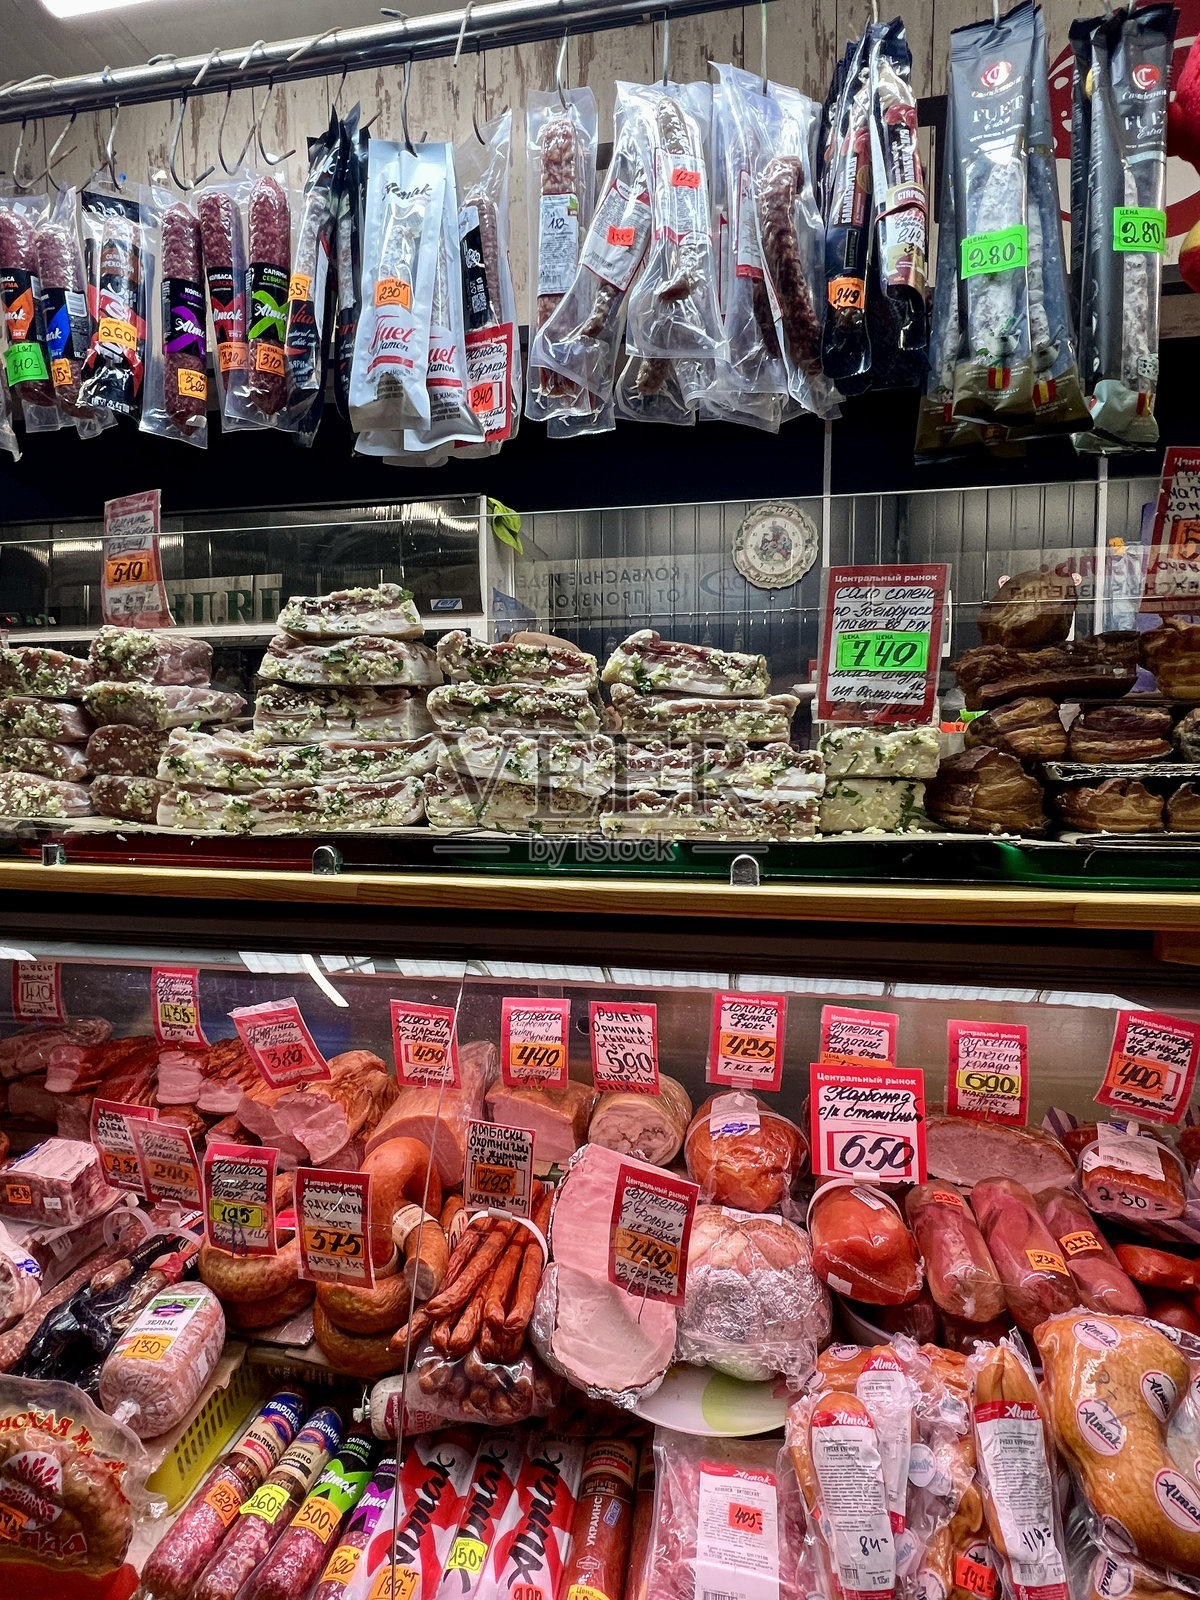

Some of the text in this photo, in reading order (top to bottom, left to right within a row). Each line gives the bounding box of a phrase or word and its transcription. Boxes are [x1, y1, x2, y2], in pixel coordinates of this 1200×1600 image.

[972, 94, 1025, 123] FUET
[835, 288, 859, 304] 249
[429, 345, 456, 366] uet
[473, 386, 493, 407] 240
[835, 574, 938, 582] Центральный рынок
[836, 587, 880, 599] Сало
[835, 619, 877, 630] тает
[886, 618, 901, 629] во
[722, 1002, 779, 1017] Лопатка
[1129, 1015, 1173, 1032] Центральный
[726, 1035, 777, 1058] 425
[817, 1072, 917, 1086] Центральный рынок
[472, 1123, 525, 1141] КОЛБАСКИ
[839, 1134, 916, 1171] 650
[480, 1172, 512, 1194] 495
[625, 1176, 690, 1202] Центральный рынок
[221, 1206, 254, 1224] 195
[310, 1229, 364, 1256] 575
[831, 1411, 872, 1428] Almak
[1080, 1407, 1121, 1450] Almak
[733, 1469, 773, 1485] Almak
